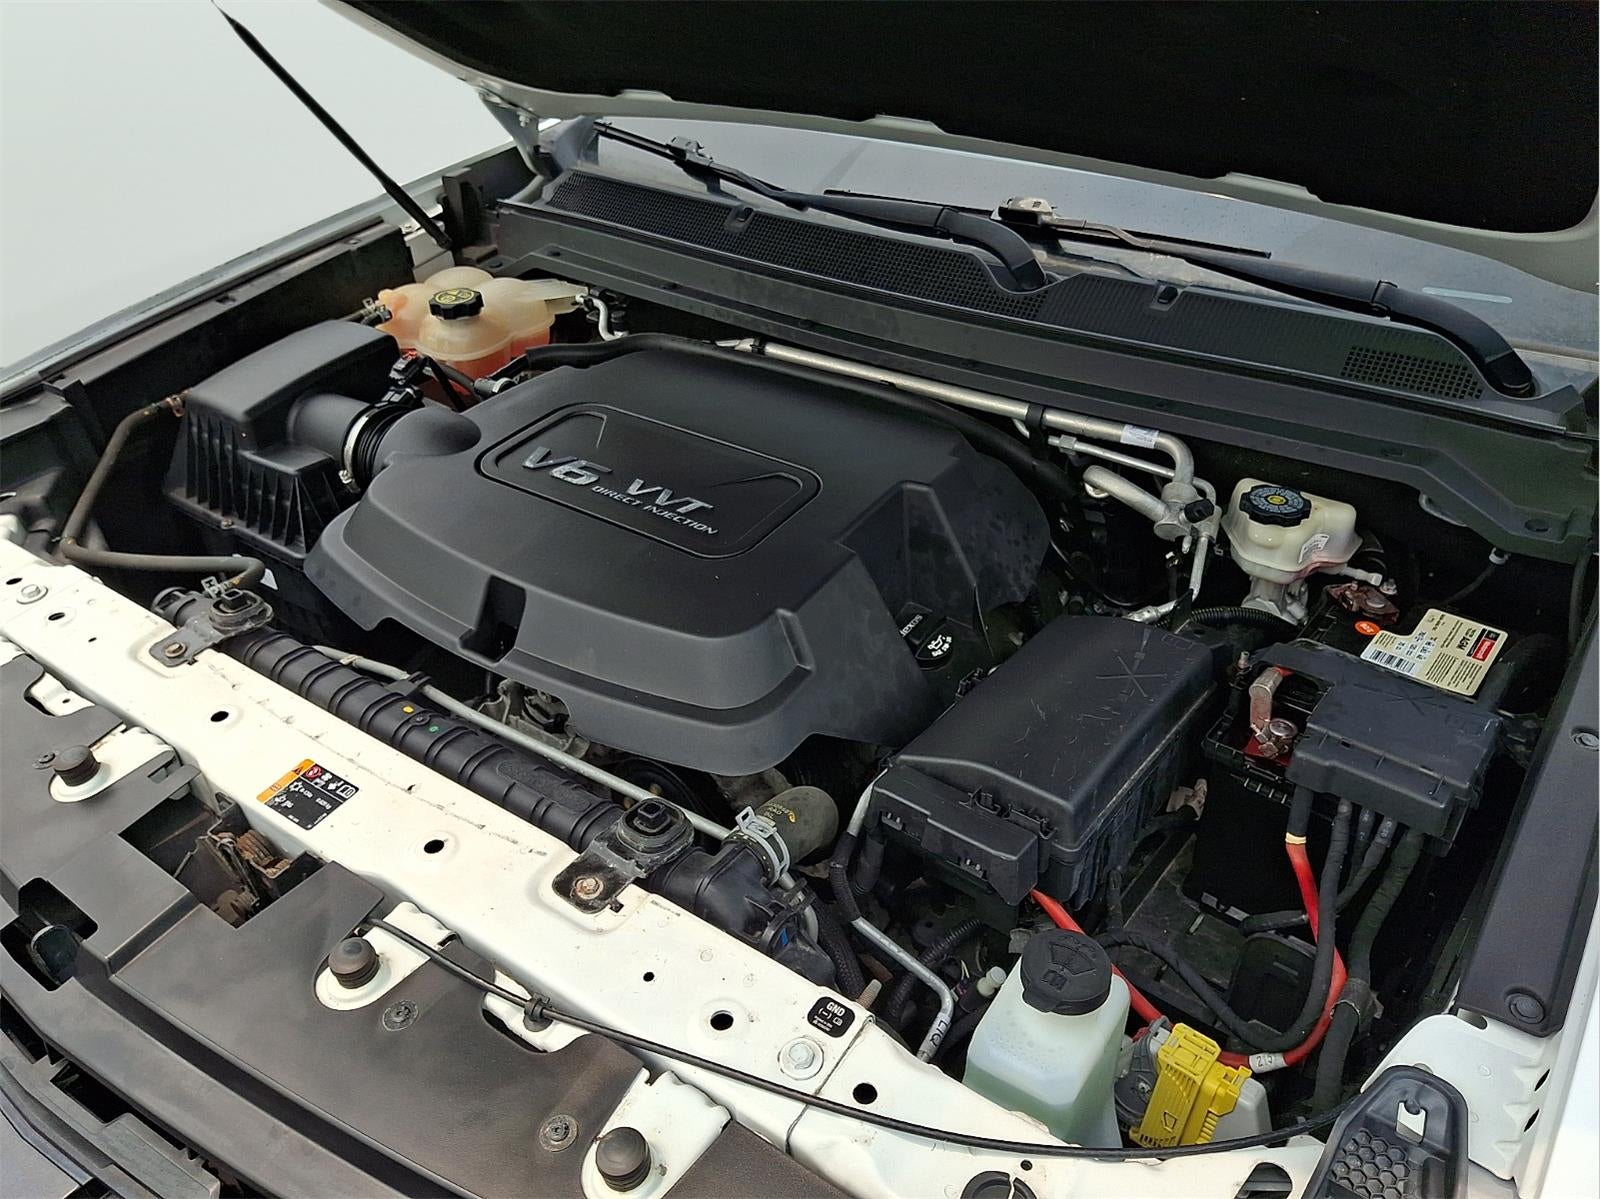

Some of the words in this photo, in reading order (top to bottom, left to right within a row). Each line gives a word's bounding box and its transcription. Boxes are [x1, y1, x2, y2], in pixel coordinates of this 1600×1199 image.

[522, 446, 613, 485] V6
[626, 478, 714, 514] VVT
[591, 485, 643, 507] DIRECT
[643, 504, 718, 535] INJECTION
[826, 1002, 846, 1017] GND
[929, 1019, 949, 1047] LIQ
